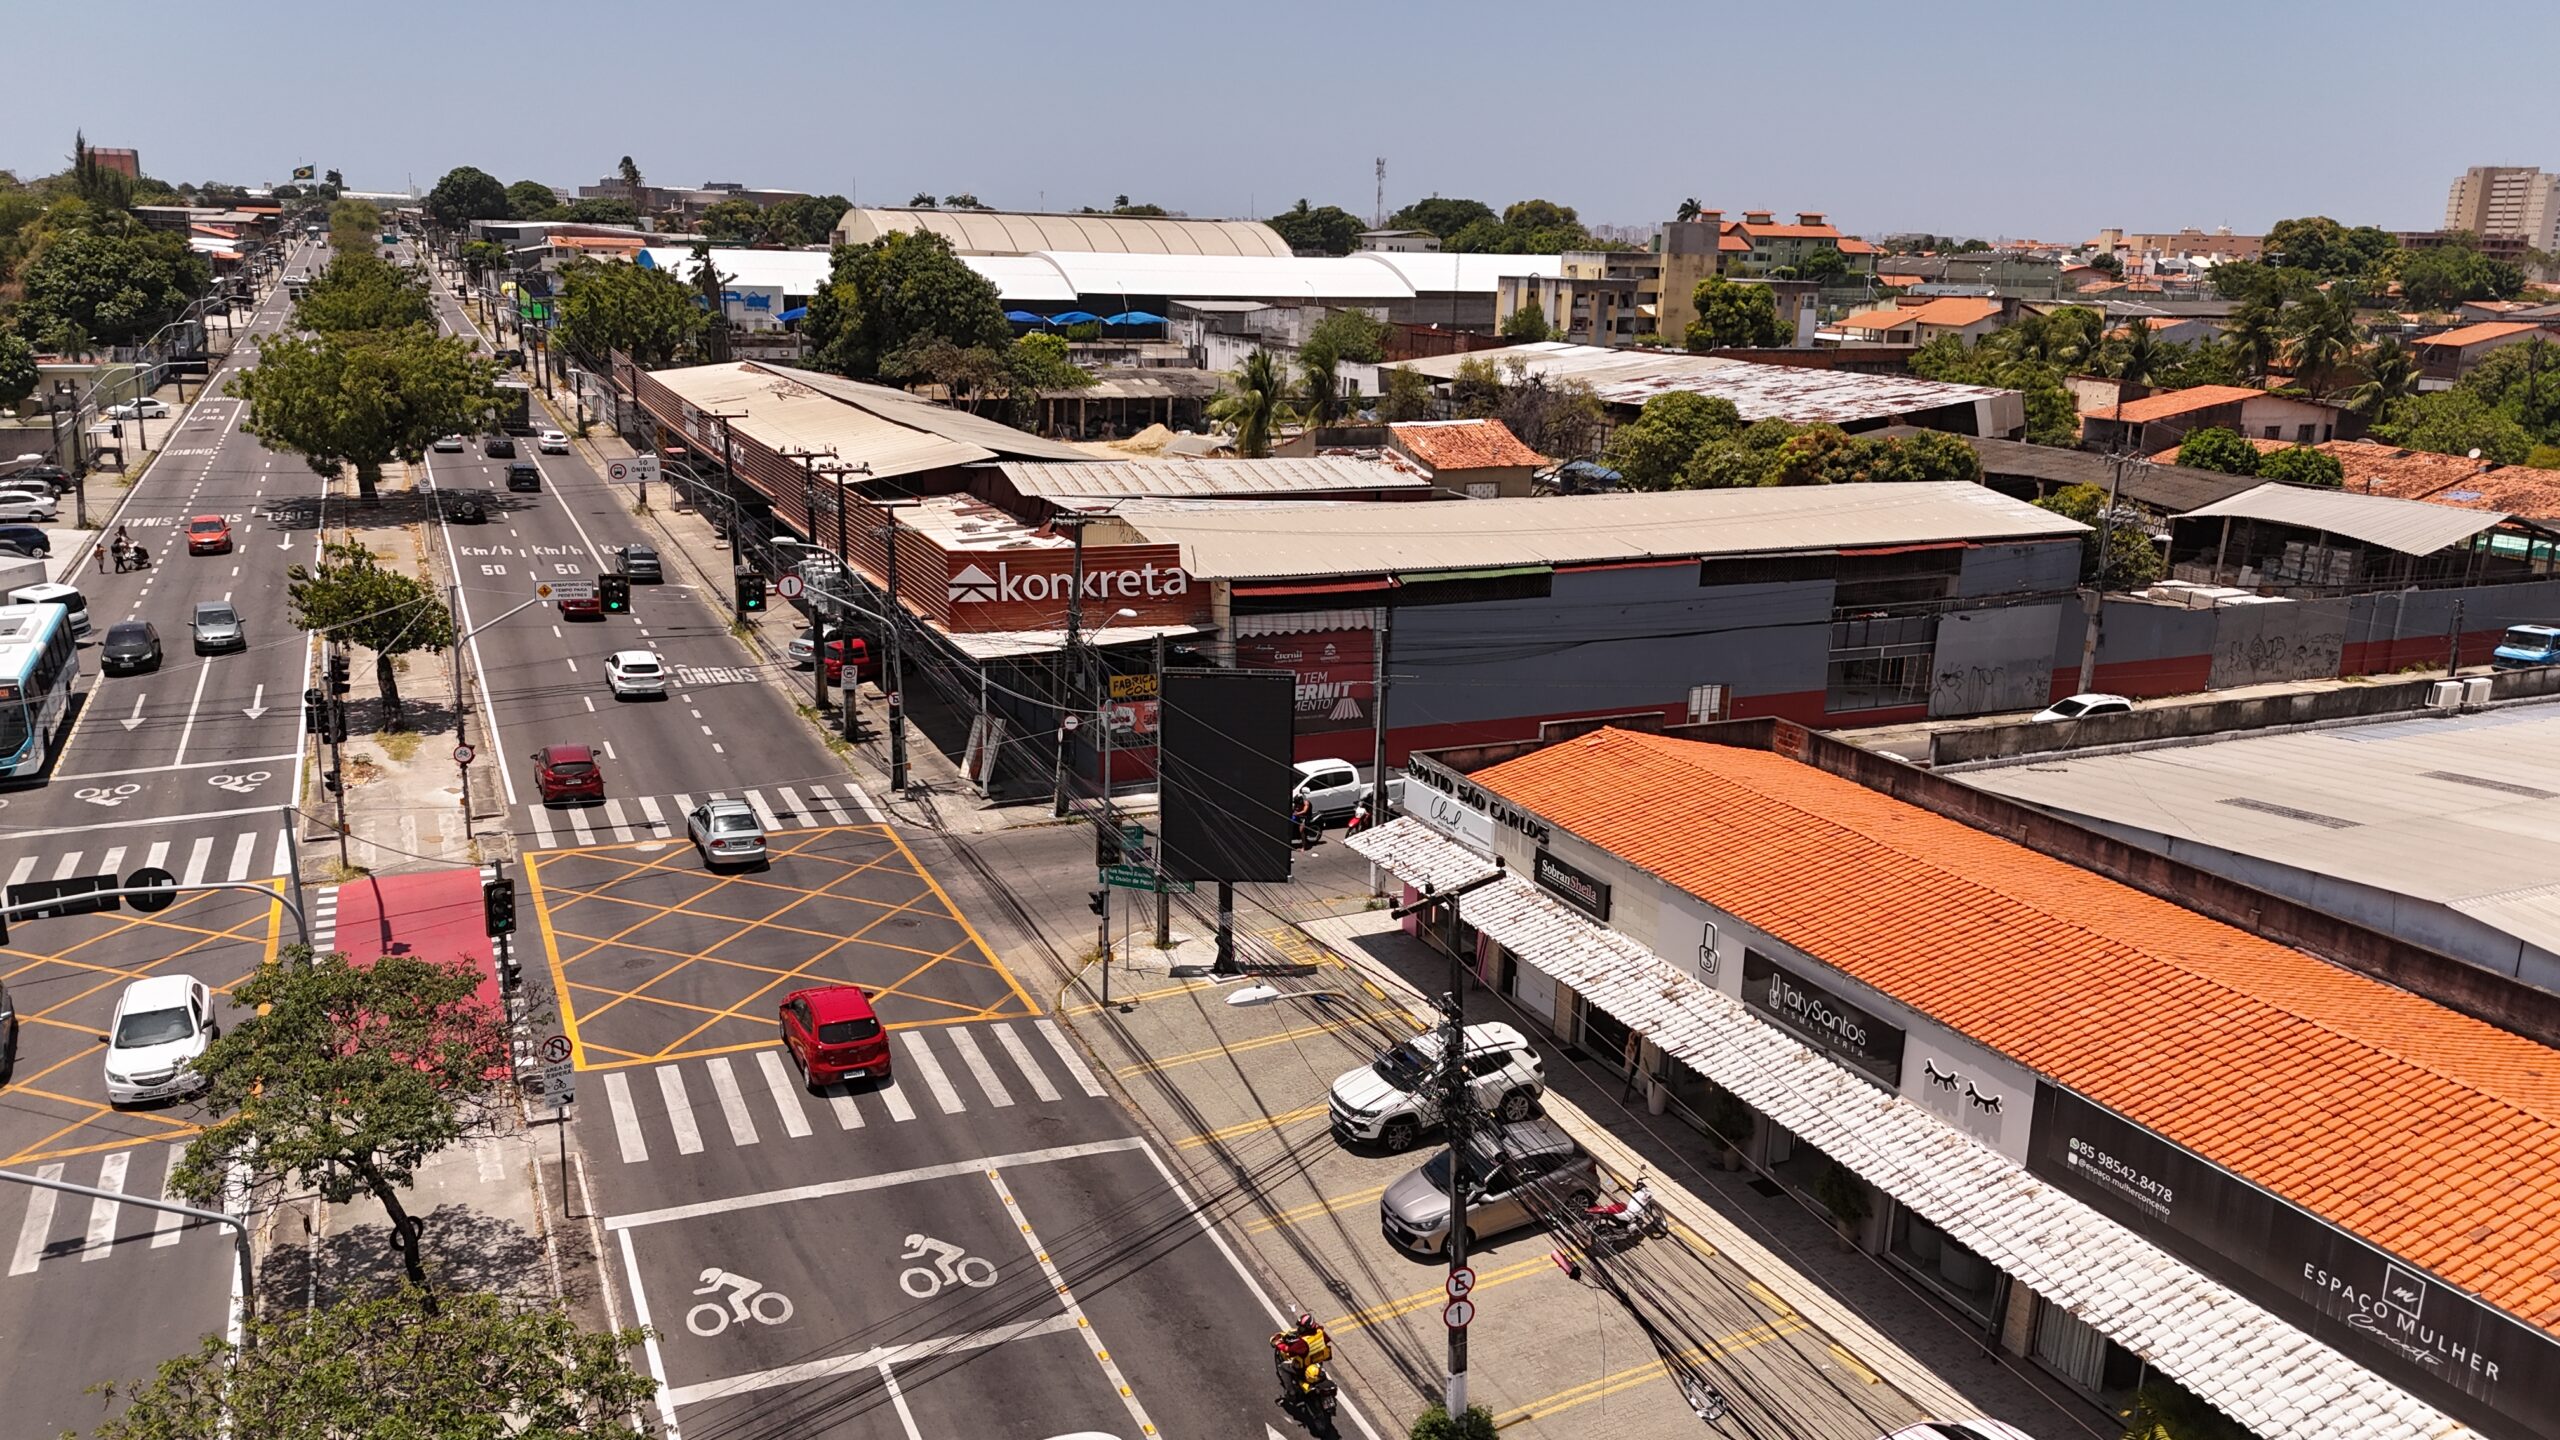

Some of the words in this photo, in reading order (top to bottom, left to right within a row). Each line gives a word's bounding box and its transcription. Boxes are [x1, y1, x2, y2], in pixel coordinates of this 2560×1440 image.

[121, 517, 173, 528] SINAL
[263, 510, 314, 522] SINAL
[481, 564, 507, 576] 50
[554, 563, 581, 575] 50
[999, 561, 1188, 602] konkreta
[674, 663, 759, 684] ÔNIBUS
[1304, 671, 1329, 684] TEM
[1417, 764, 1454, 795] PÁTIO
[1457, 783, 1487, 811] SÃO
[1489, 801, 1551, 845] CARLOS
[1782, 1007, 1864, 1058] ESMALTERIA
[2079, 1142, 2096, 1159] 85
[2097, 1151, 2173, 1203] 98542.8478
[2303, 1262, 2388, 1319] ESPAÇO
[2396, 1312, 2500, 1382] MULHER
[2347, 1312, 2445, 1366] Conceito
